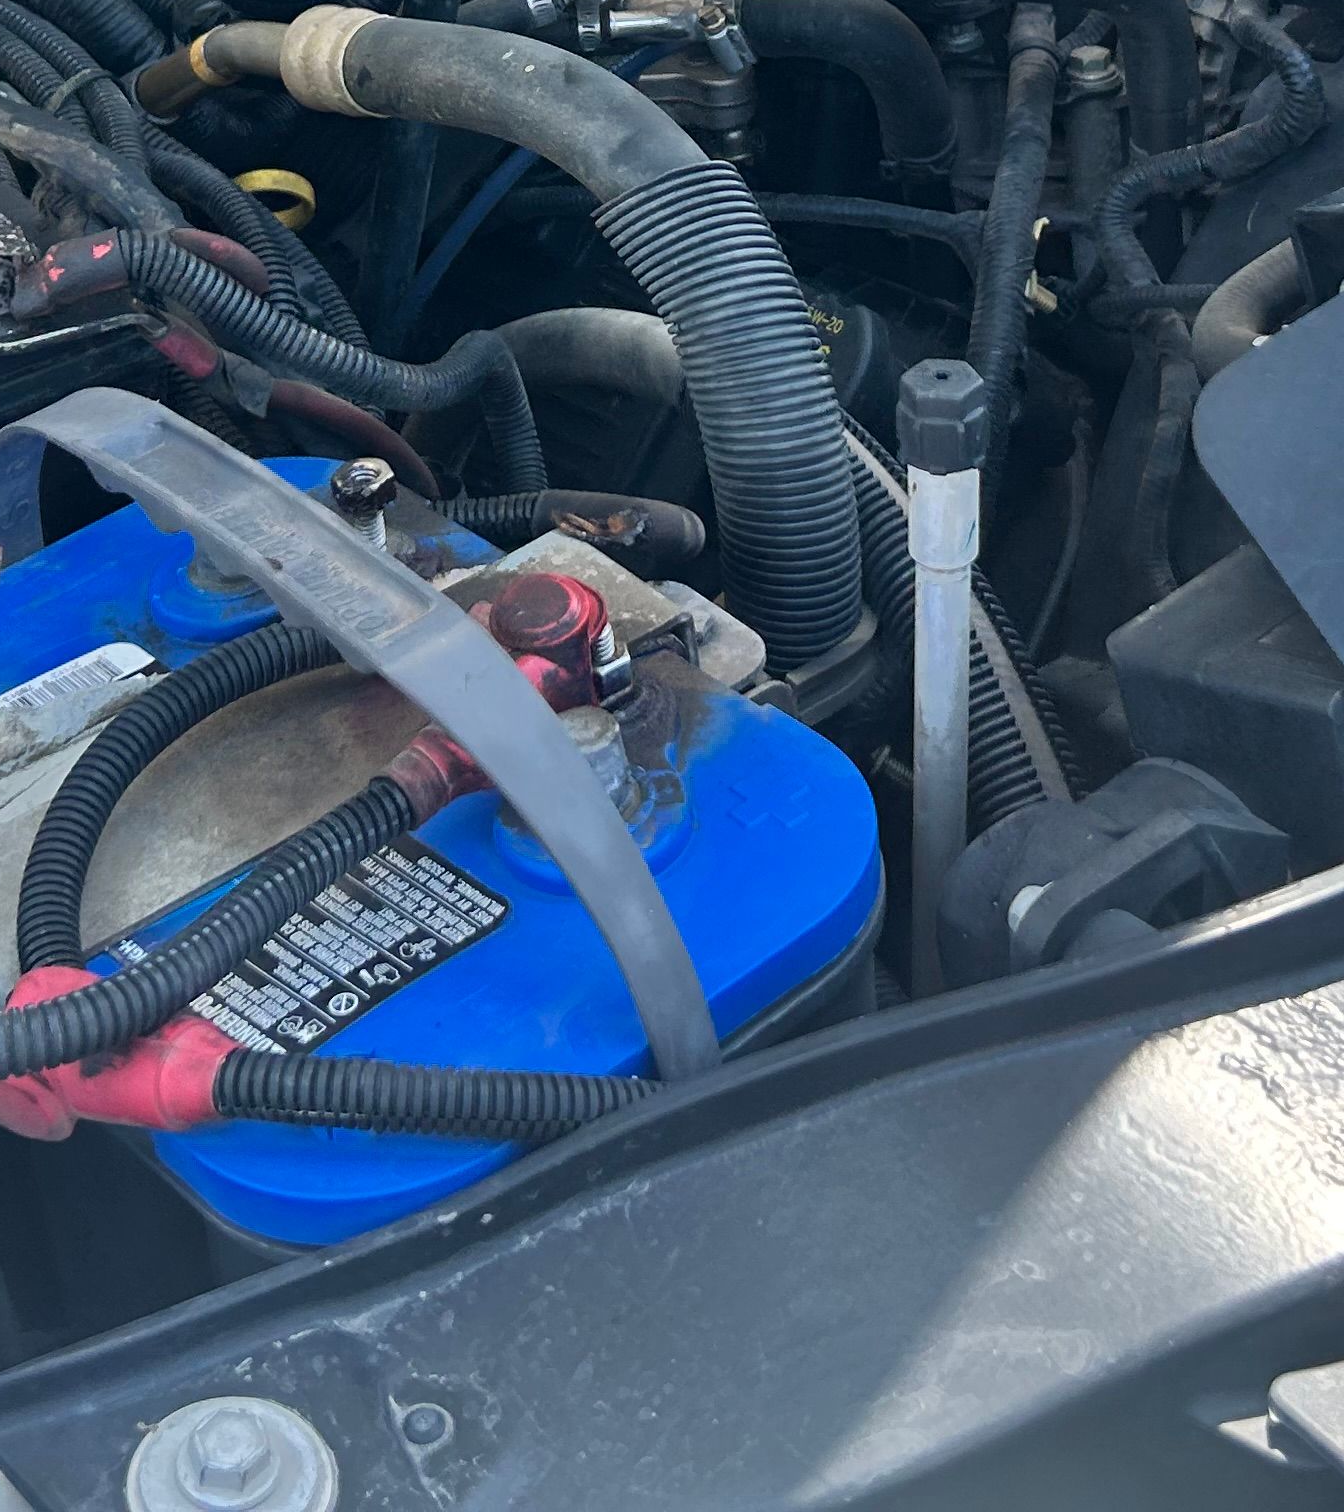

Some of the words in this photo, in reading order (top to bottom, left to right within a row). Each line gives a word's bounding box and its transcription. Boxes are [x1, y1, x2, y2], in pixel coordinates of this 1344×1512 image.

[363, 873, 381, 886] OF
[383, 872, 411, 891] OPEN
[438, 870, 459, 884] WI
[373, 880, 405, 902] REACH
[402, 885, 426, 902] NOT
[423, 877, 462, 903] OPTIMA
[397, 896, 419, 912] THE
[418, 895, 438, 910] DO
[453, 896, 474, 911] BY
[412, 906, 431, 919] OF
[423, 913, 447, 930] OUT
[298, 981, 321, 999] NO
